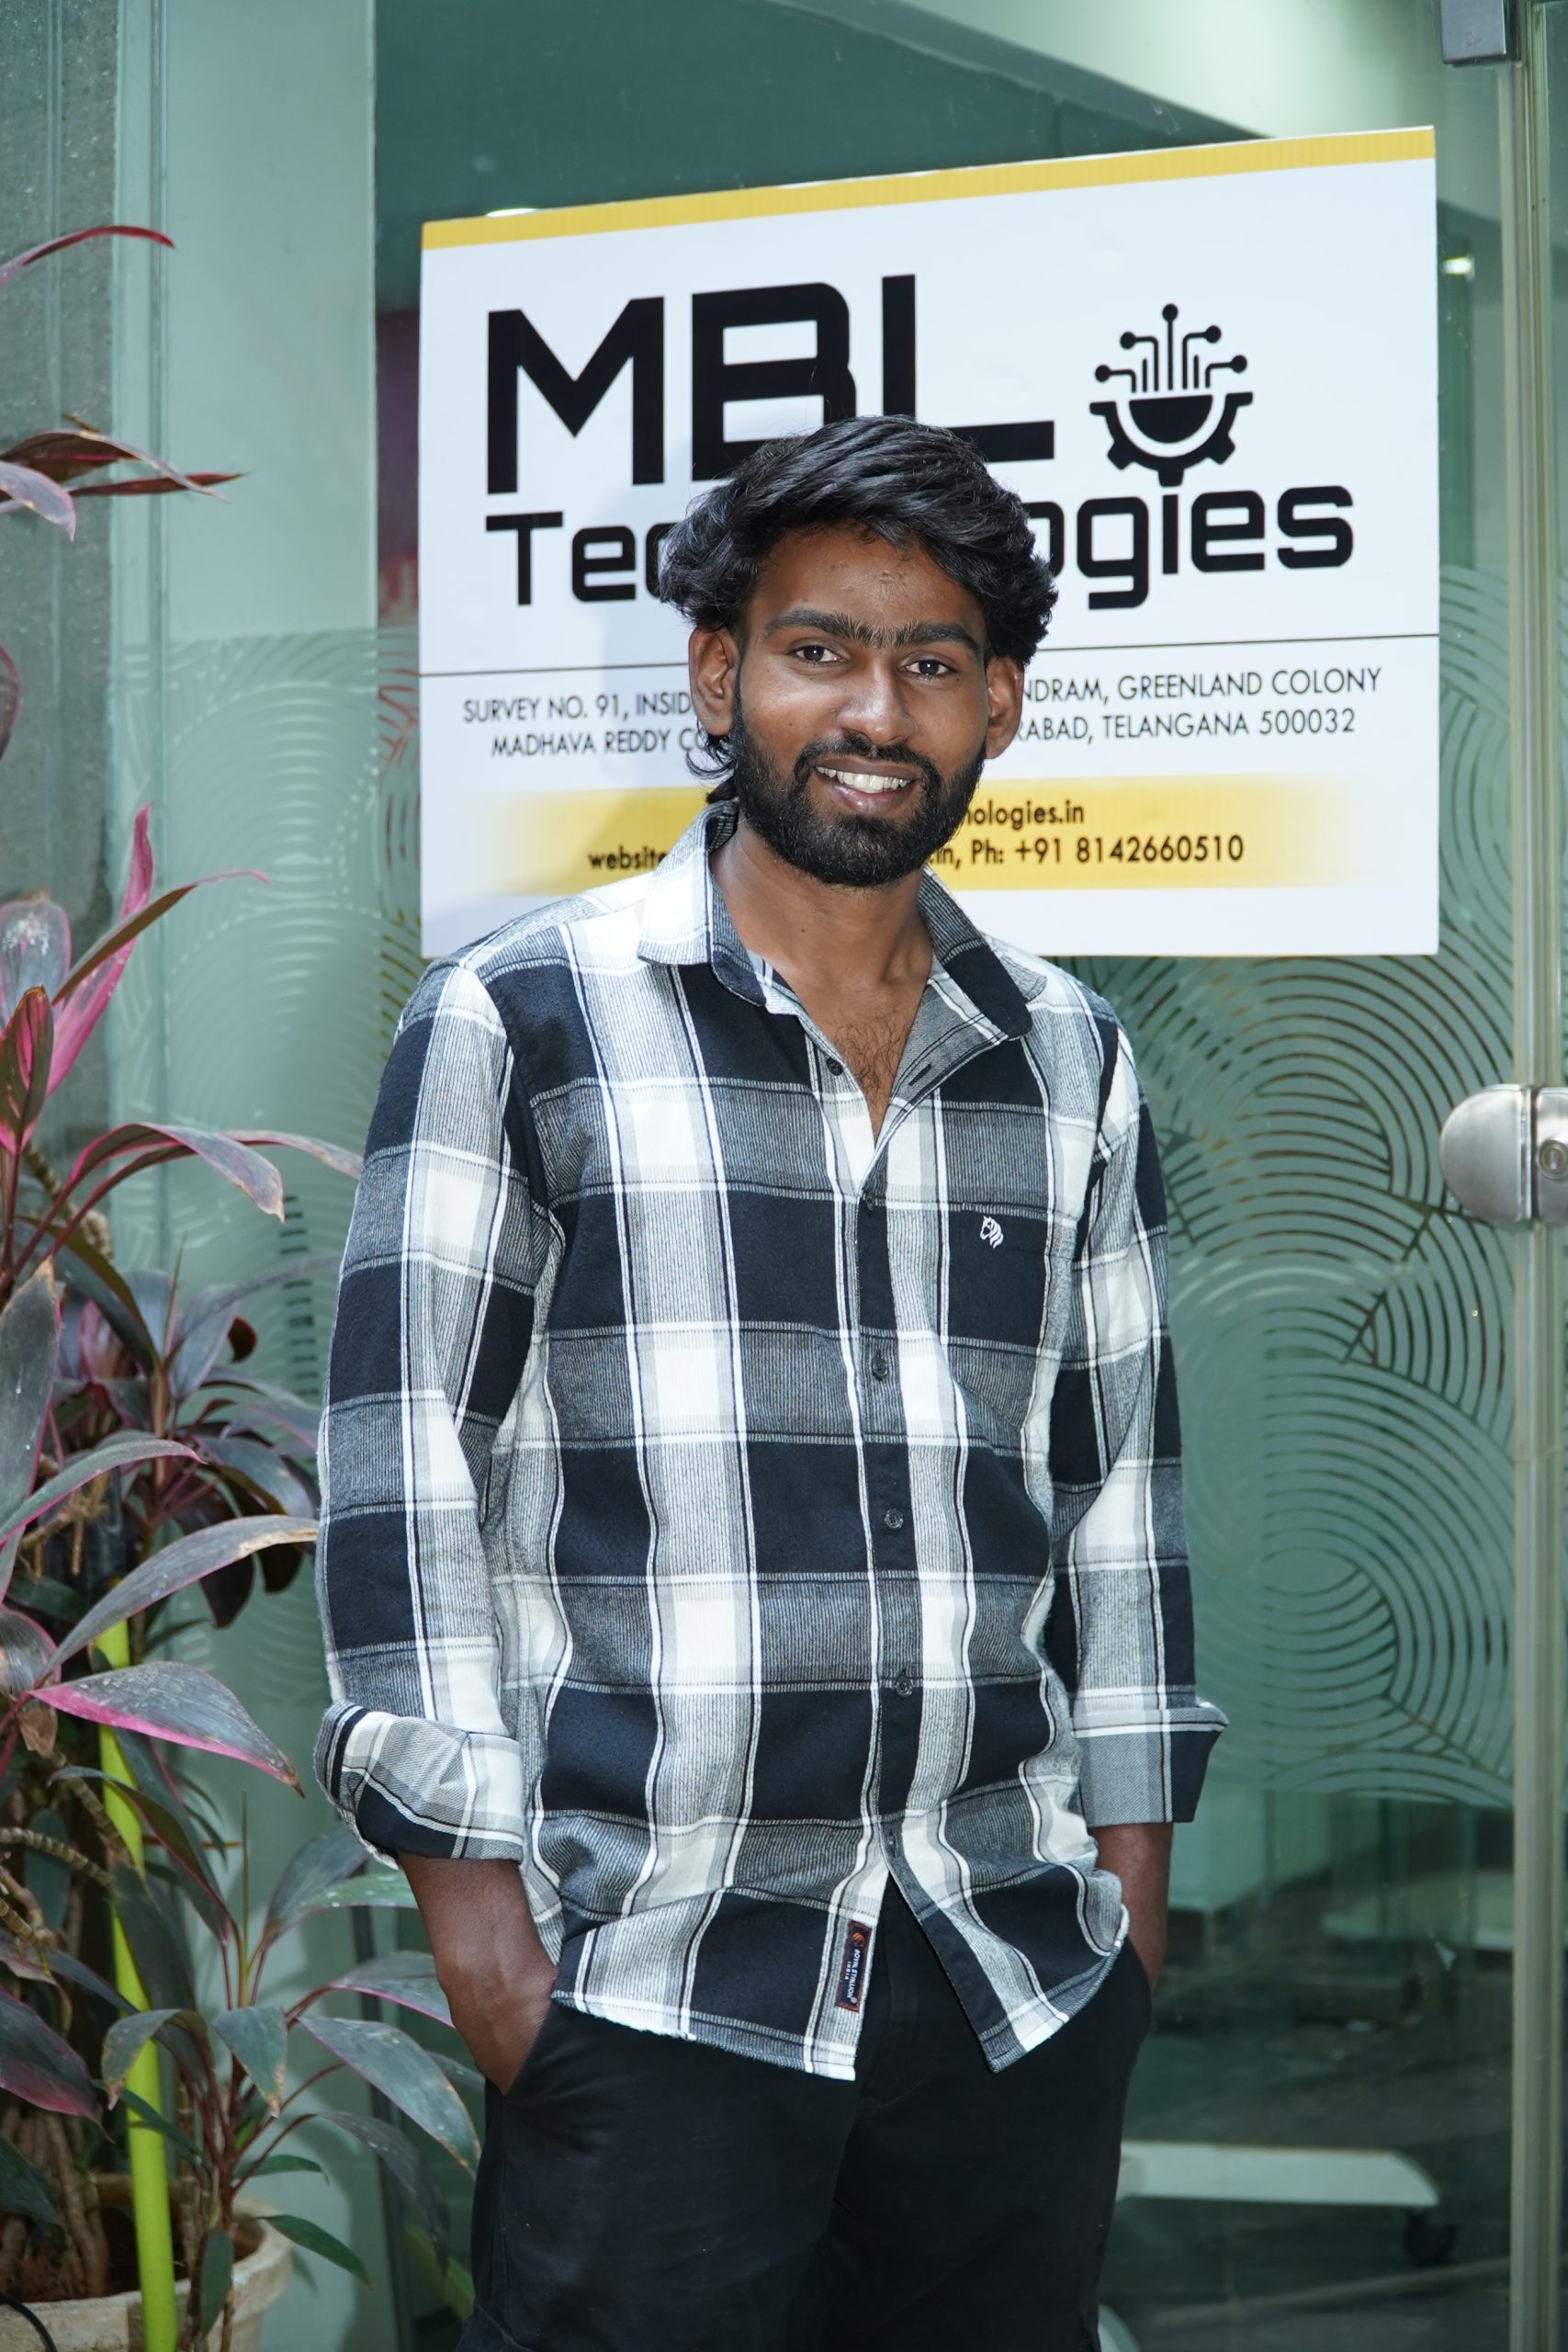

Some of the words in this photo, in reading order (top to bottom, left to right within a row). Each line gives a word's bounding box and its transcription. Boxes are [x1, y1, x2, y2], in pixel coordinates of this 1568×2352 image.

[487, 274, 1055, 494] MBL
[463, 696, 540, 723] SURVEY
[547, 695, 589, 719] NO.
[595, 694, 629, 722] 91,
[636, 691, 693, 716] INSID
[1117, 671, 1263, 701] GREENLAND
[1271, 667, 1382, 695] COLONY
[491, 731, 596, 757] MADHAVA
[604, 729, 671, 753] REDDY
[1101, 712, 1249, 740] TELANGANA
[1258, 707, 1356, 736] 500032
[971, 838, 1004, 865] Ph:
[1014, 837, 1061, 865] +91
[1076, 834, 1245, 865] 8142660510
